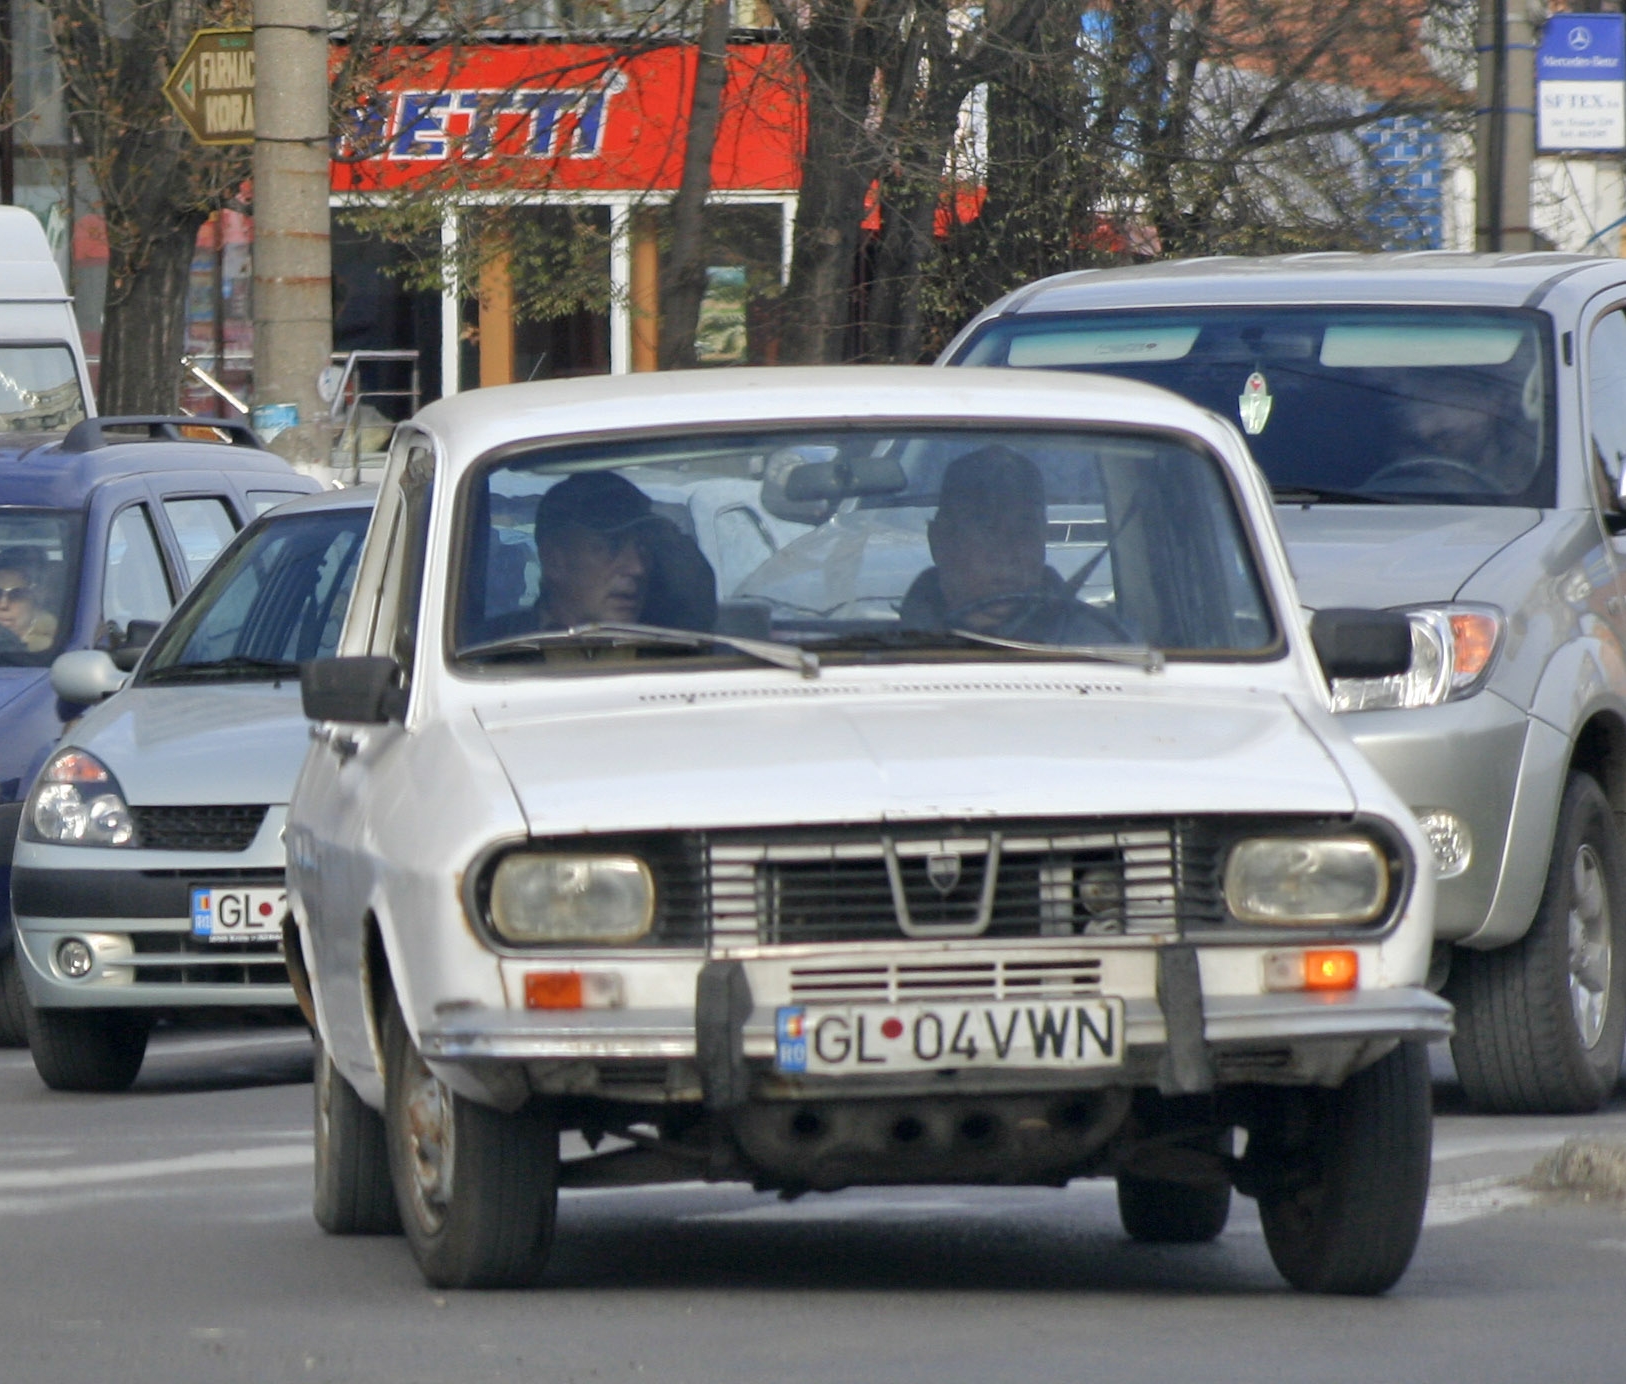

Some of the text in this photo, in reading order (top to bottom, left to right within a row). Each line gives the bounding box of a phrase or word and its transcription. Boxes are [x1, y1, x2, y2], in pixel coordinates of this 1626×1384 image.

[205, 94, 254, 133] KORA
[219, 894, 264, 928] GL
[814, 1006, 1114, 1065] GL 04VWN
